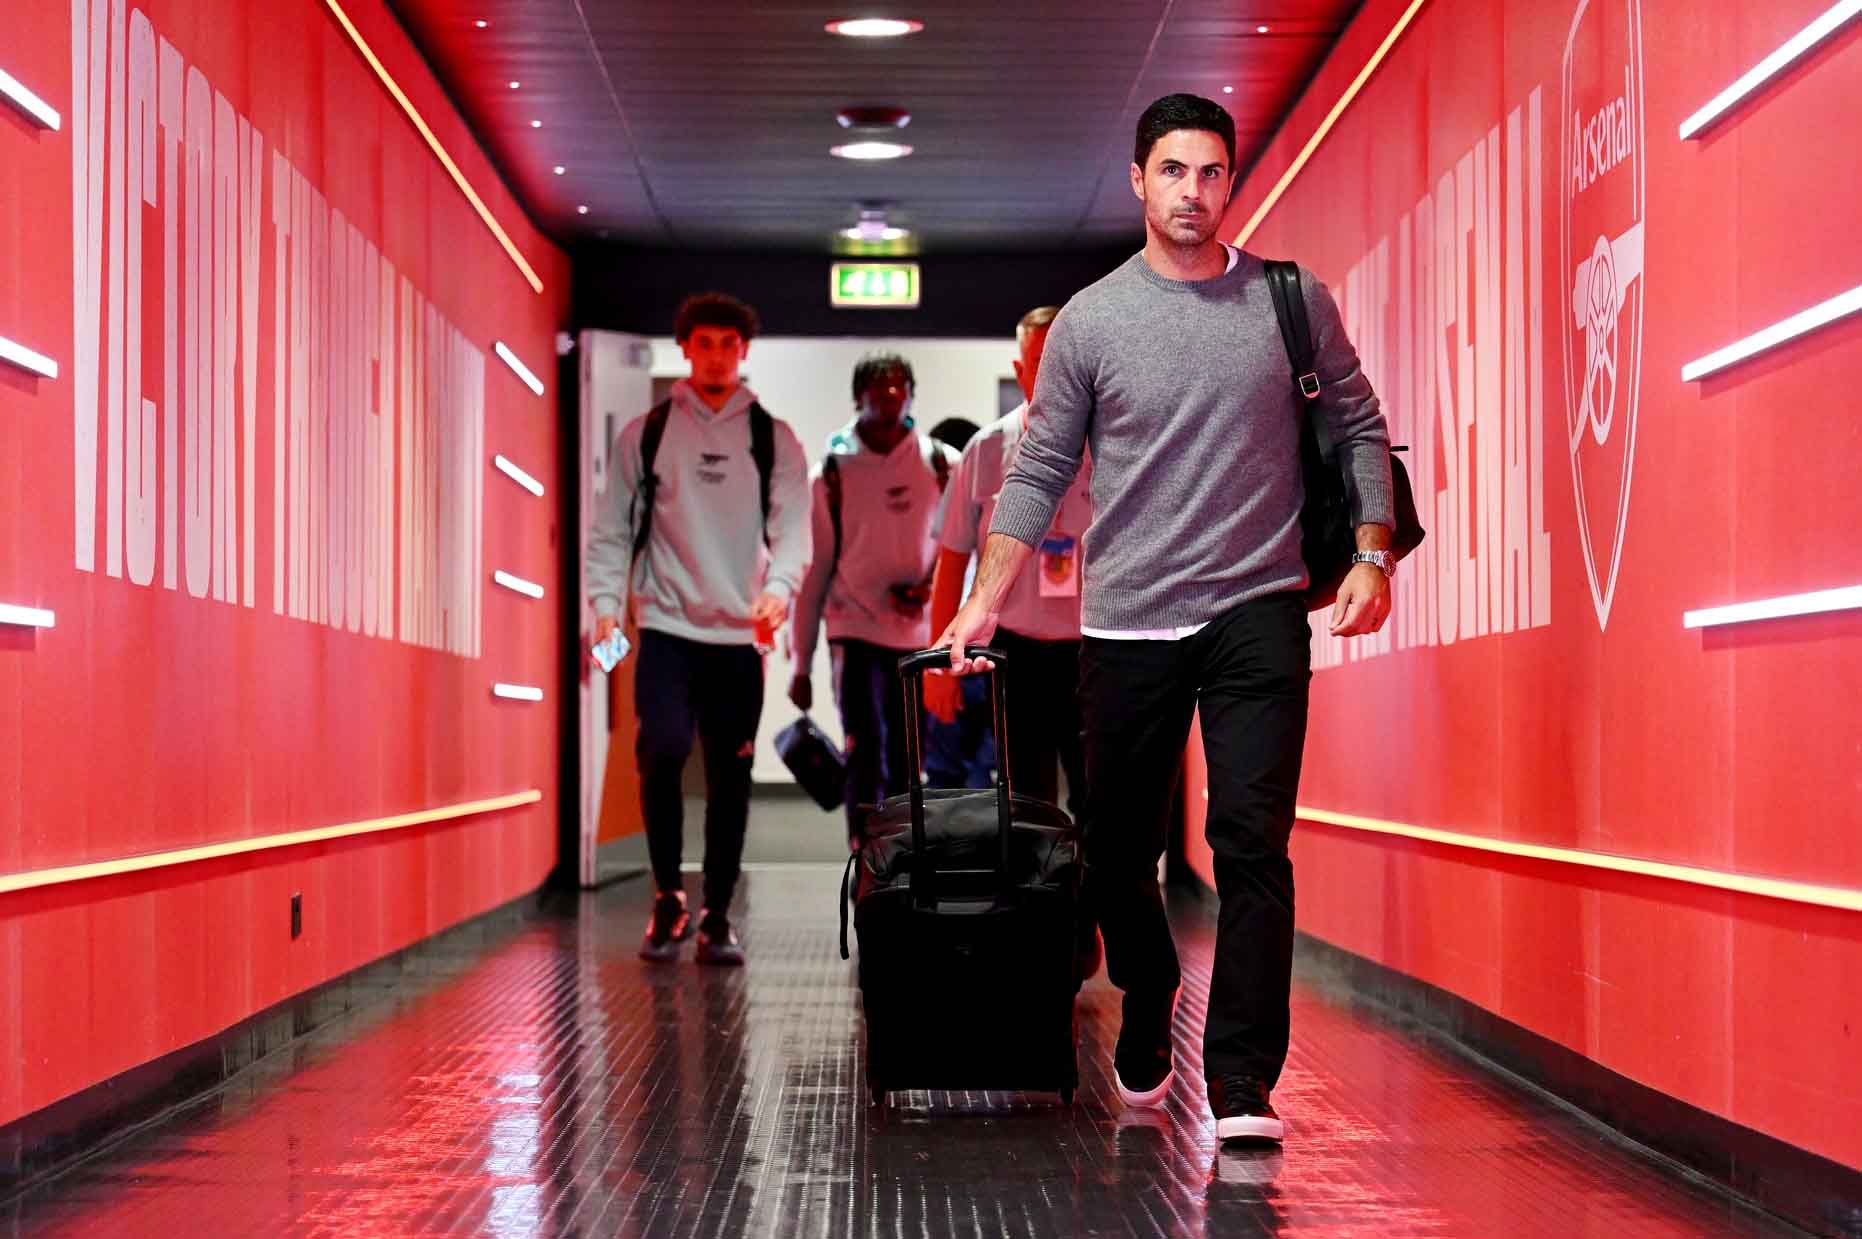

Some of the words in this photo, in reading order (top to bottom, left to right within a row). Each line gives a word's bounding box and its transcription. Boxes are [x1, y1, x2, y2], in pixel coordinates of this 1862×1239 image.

[71, 0, 263, 609] VICTORY
[272, 148, 395, 640] THROUGH
[1396, 85, 1552, 651] ARSENAL
[1571, 63, 1632, 200] Arsenal
